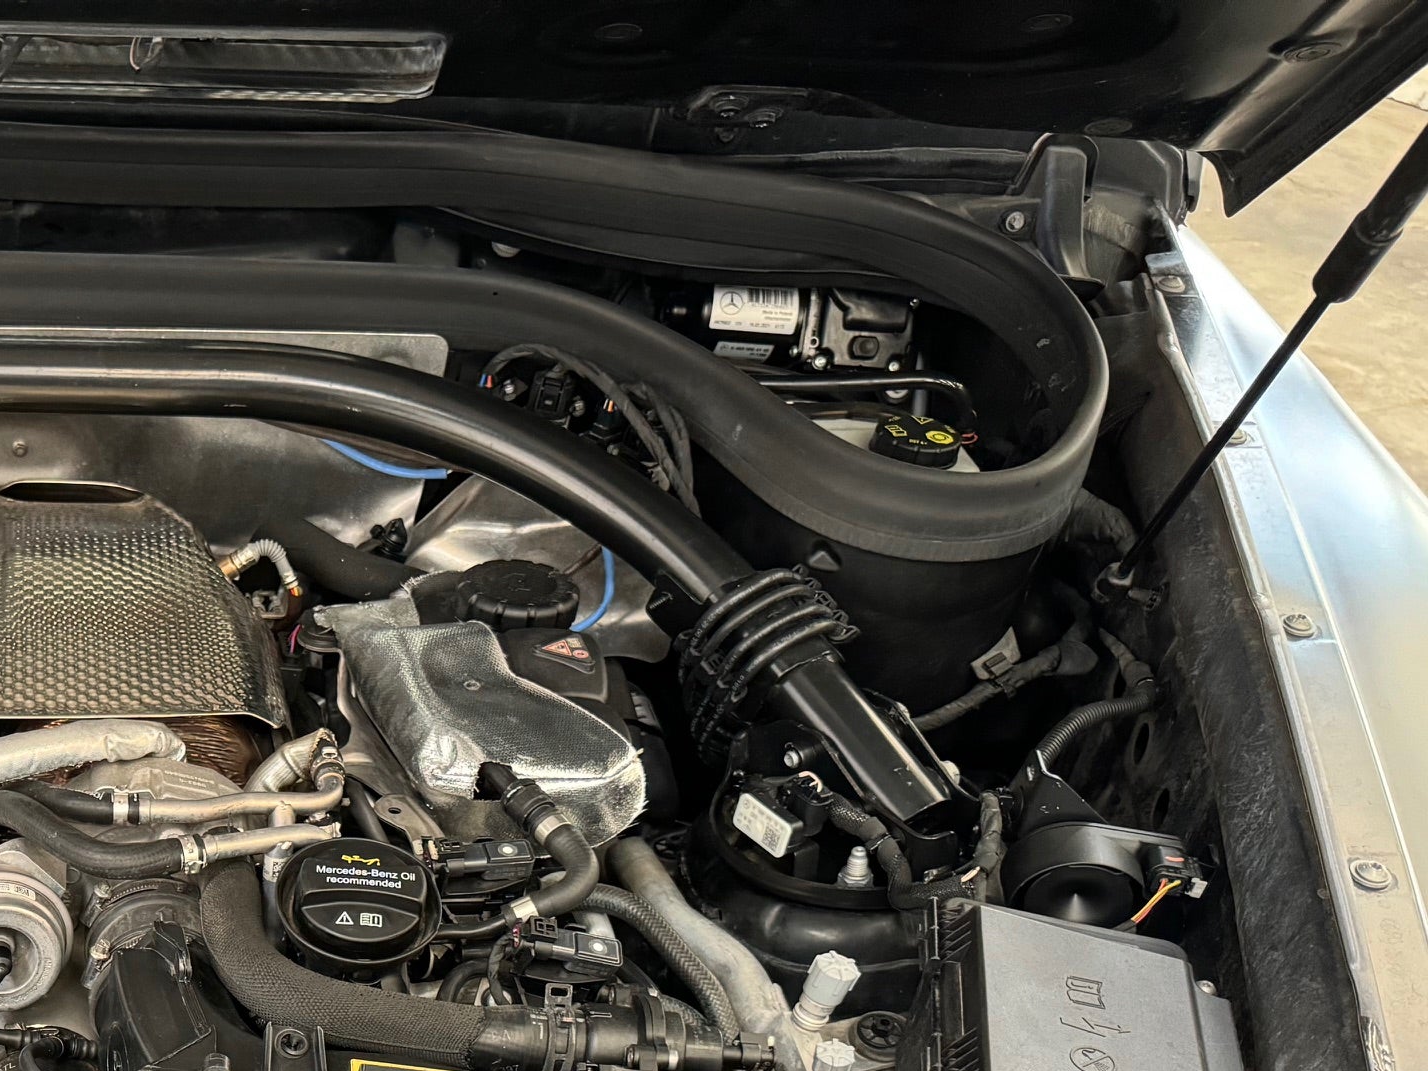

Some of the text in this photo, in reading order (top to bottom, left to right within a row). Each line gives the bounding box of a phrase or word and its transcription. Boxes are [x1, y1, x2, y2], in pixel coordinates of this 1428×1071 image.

[316, 865, 416, 881] Mercedes-Benz Oil
[326, 876, 402, 888] recommended
